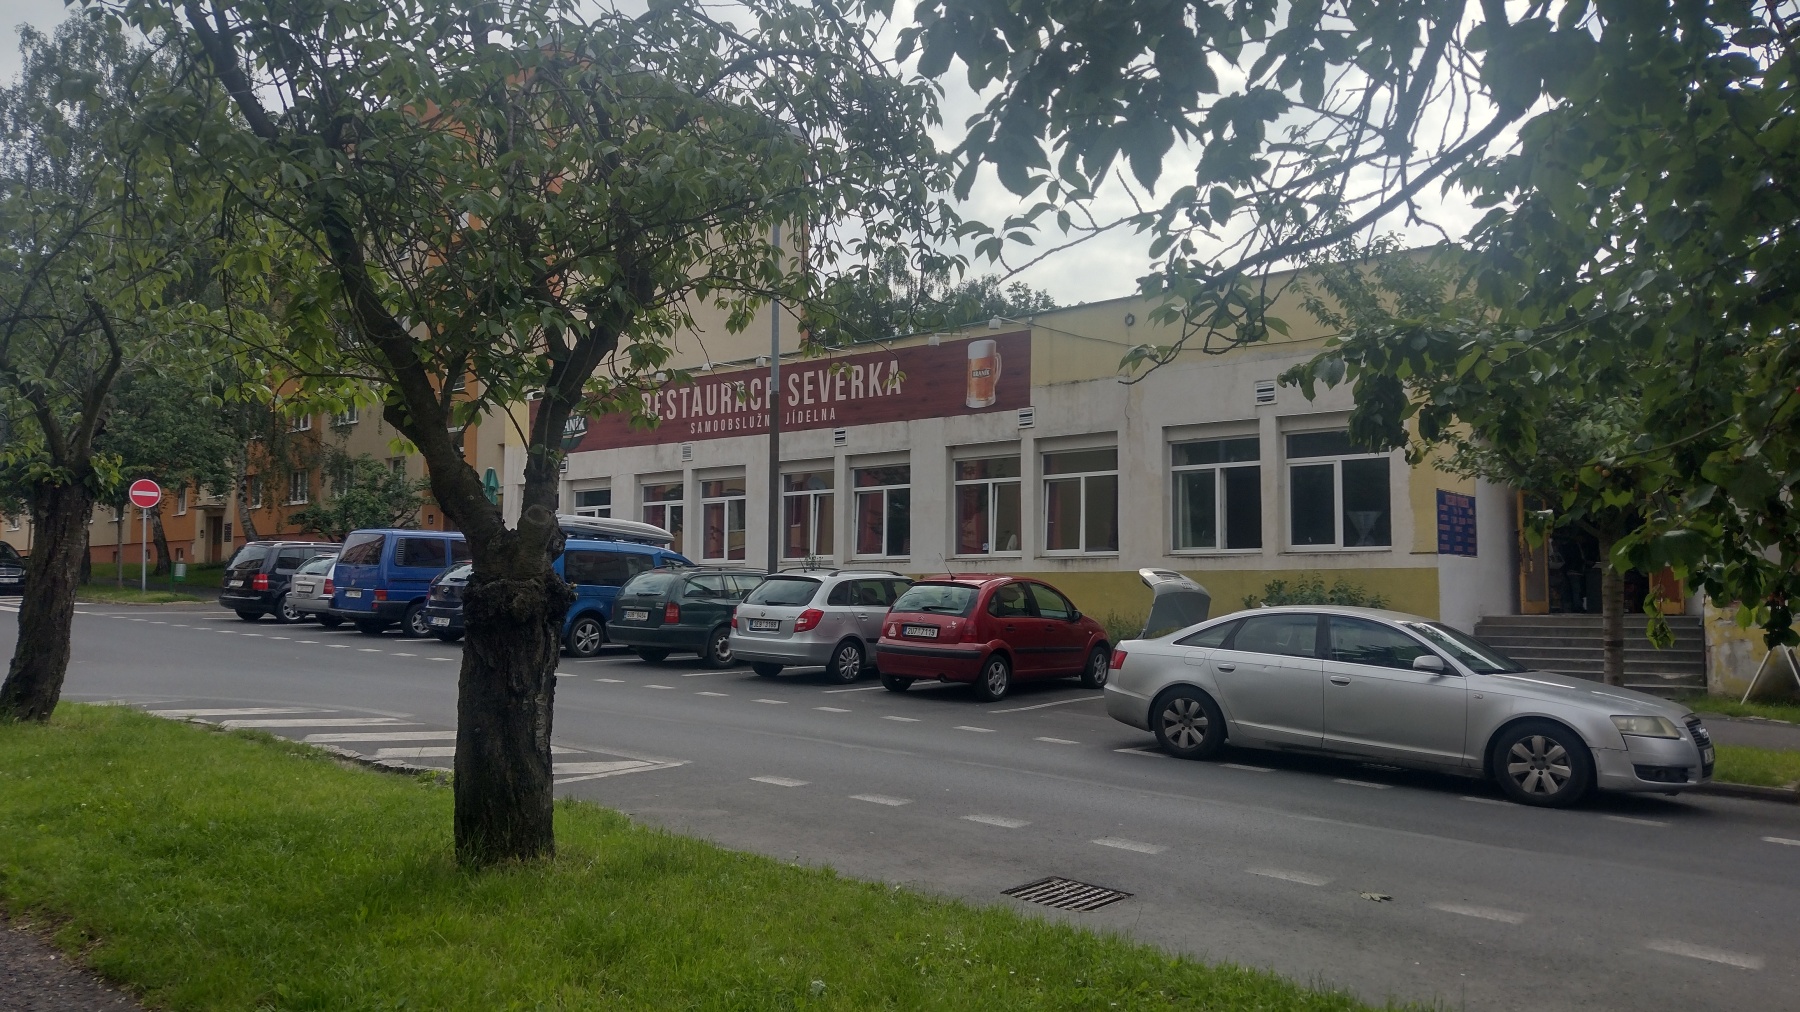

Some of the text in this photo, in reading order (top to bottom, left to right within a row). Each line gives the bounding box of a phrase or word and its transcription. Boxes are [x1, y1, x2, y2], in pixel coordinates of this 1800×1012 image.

[787, 359, 902, 407] SEVERKA
[564, 416, 585, 431] ANÍK
[690, 407, 837, 435] SAMOOBSLUŽN JÍDELNA
